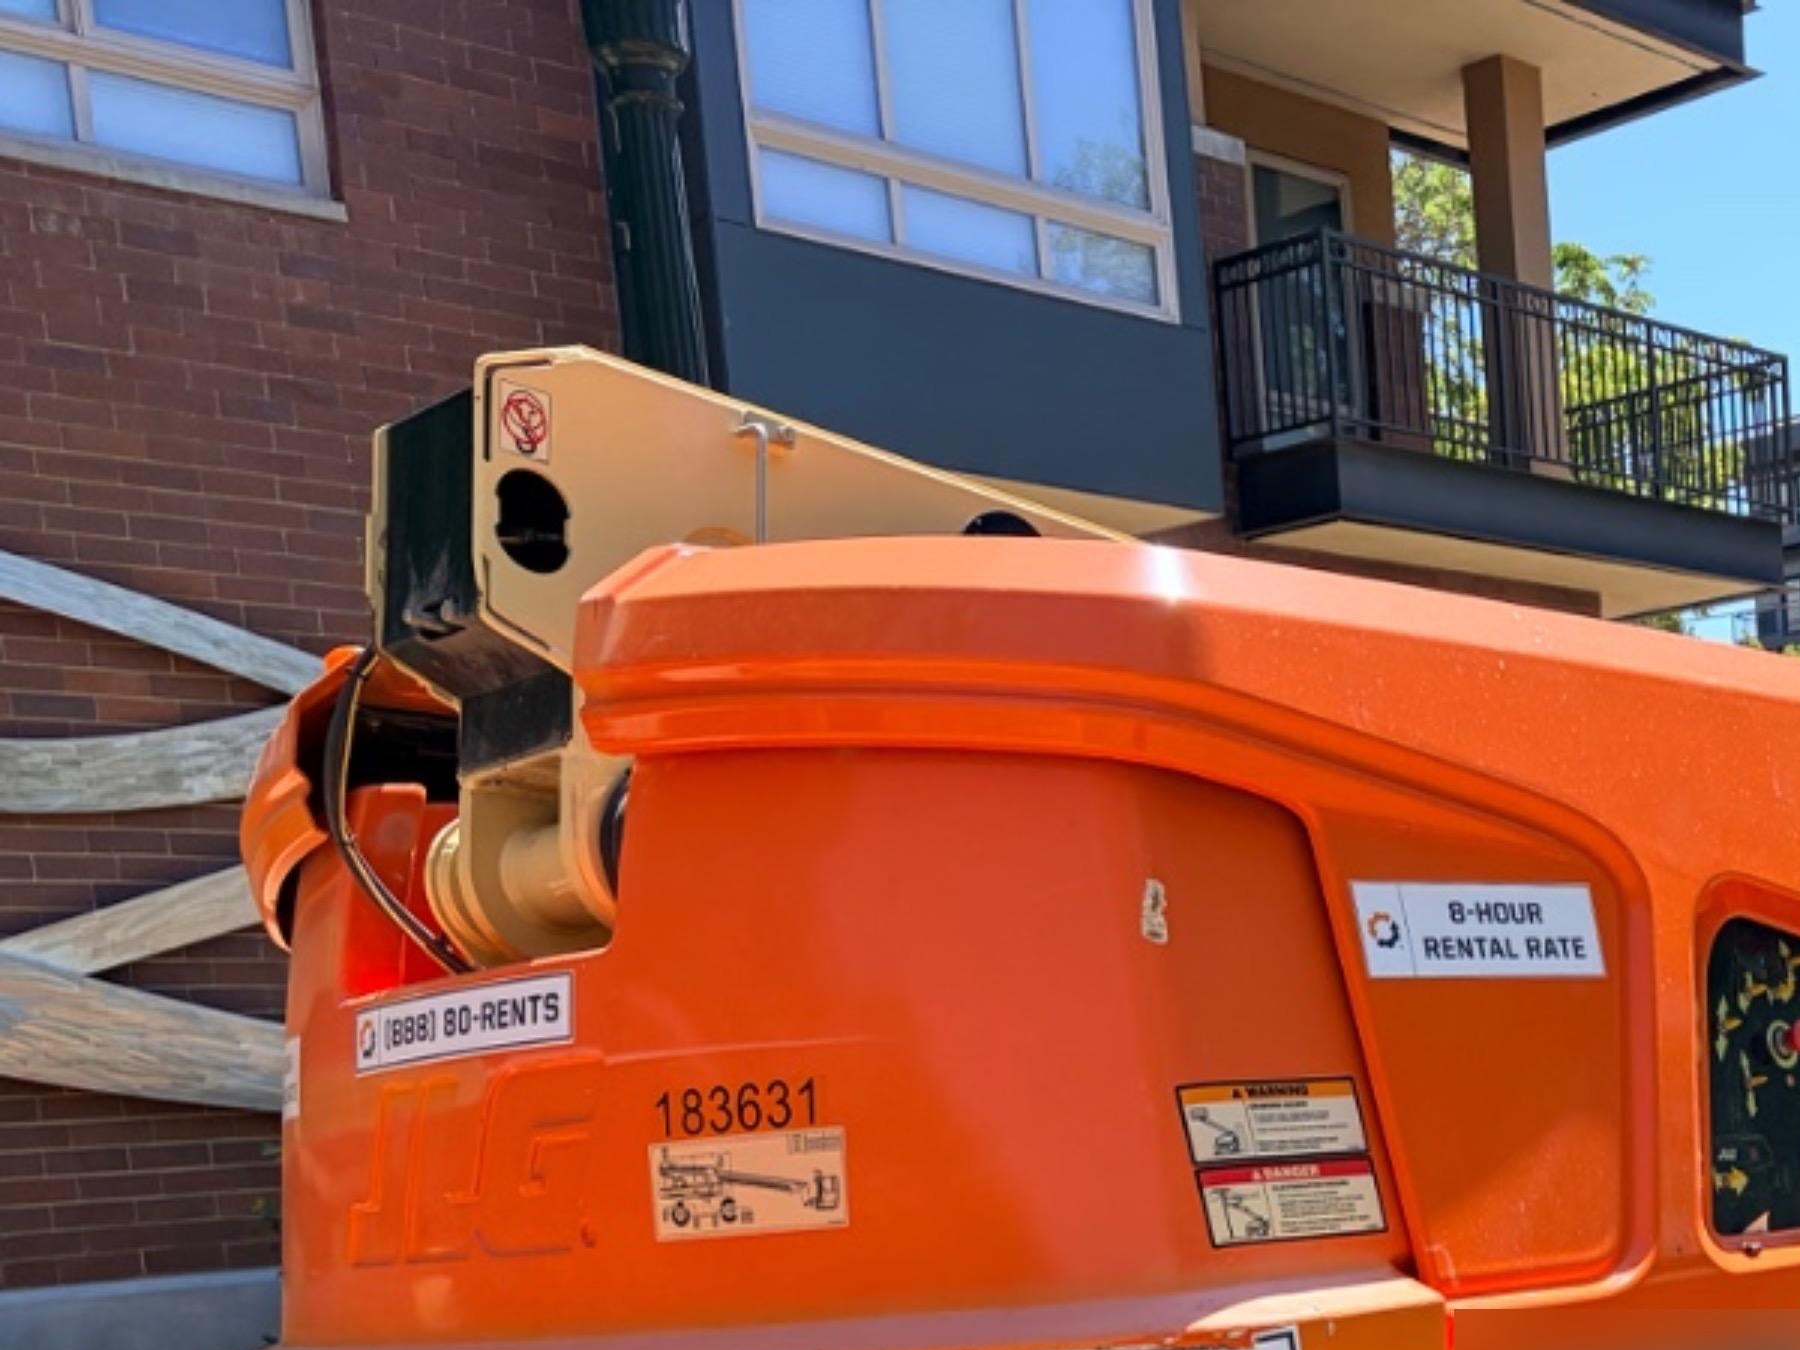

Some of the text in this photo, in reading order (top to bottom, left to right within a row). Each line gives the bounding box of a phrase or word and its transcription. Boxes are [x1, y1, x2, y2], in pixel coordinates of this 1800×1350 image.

[1448, 900, 1544, 926] 8-HOUR
[1423, 935, 1588, 961] RENTAL RATE
[443, 991, 560, 1038] 80-RENTS
[656, 1077, 816, 1137] 183631
